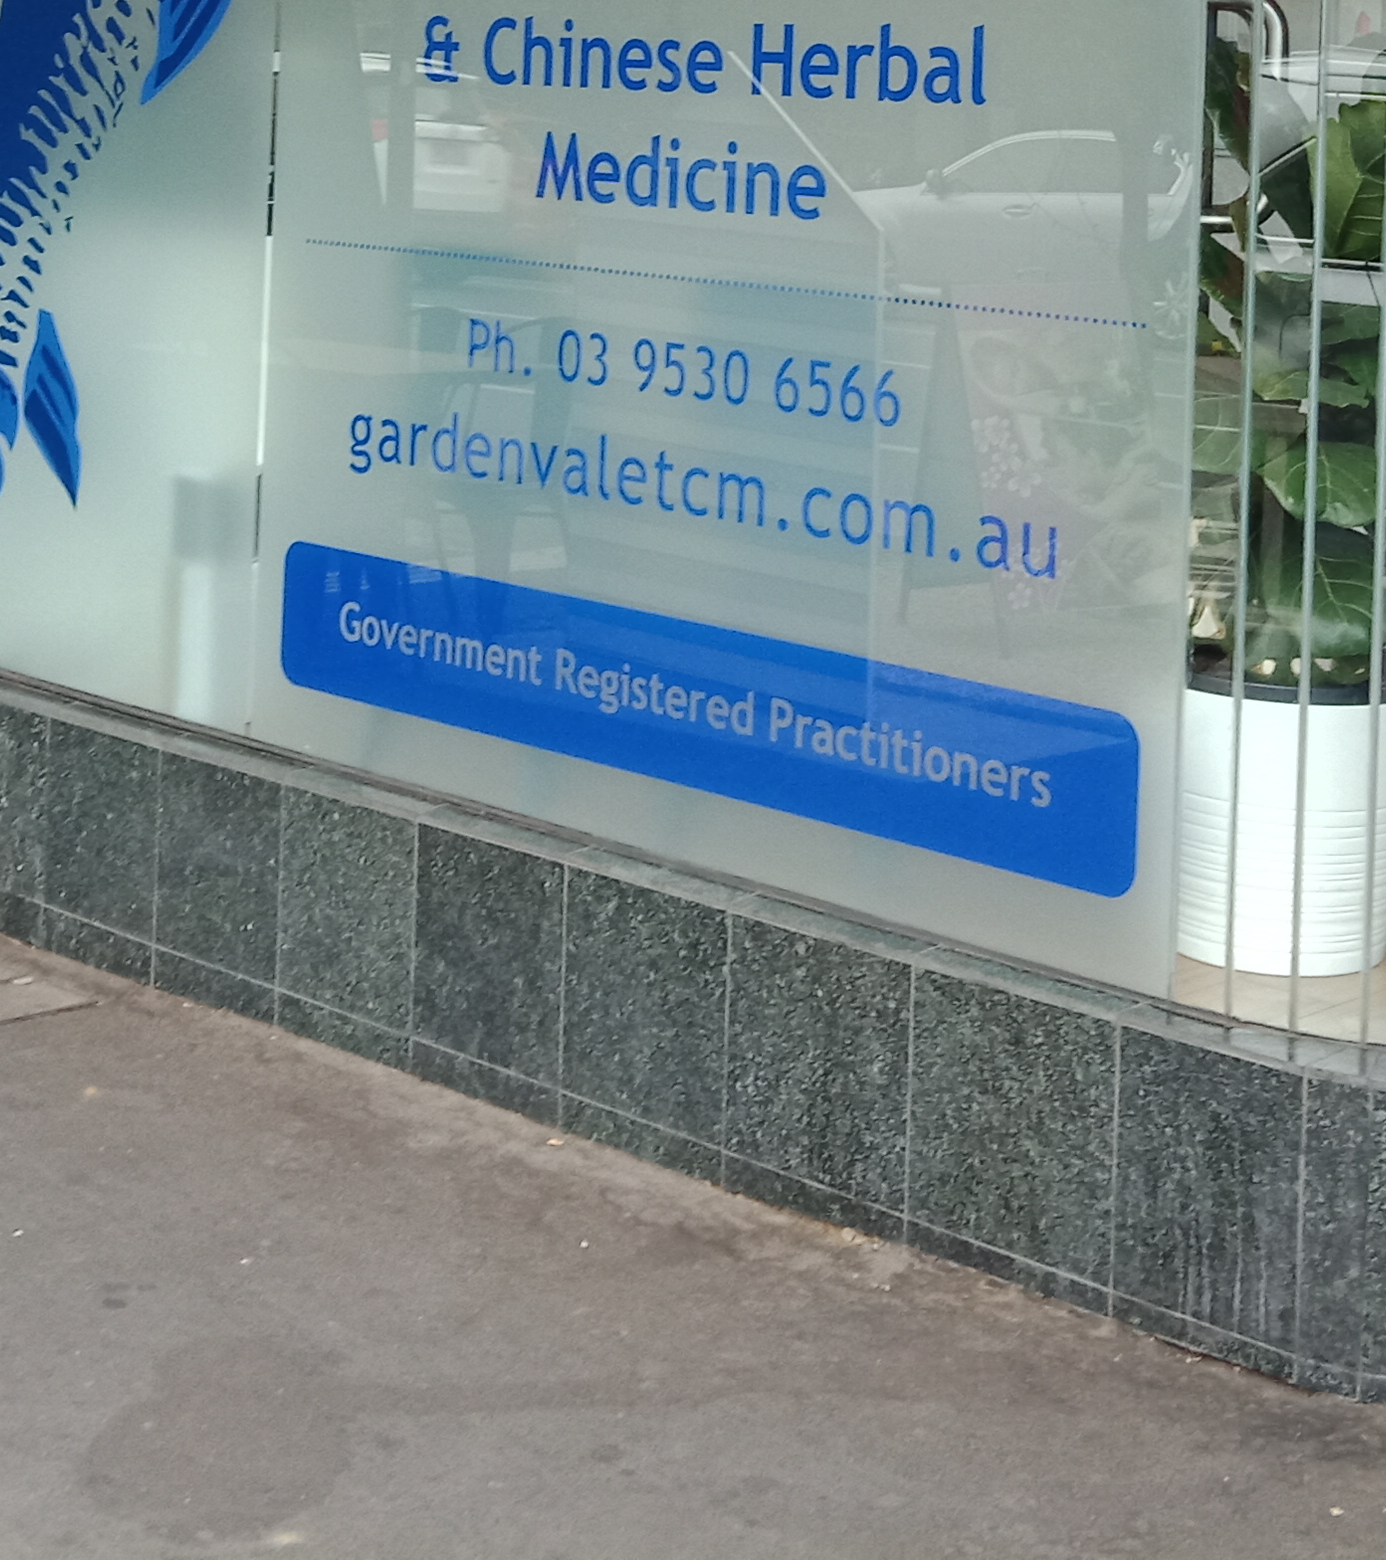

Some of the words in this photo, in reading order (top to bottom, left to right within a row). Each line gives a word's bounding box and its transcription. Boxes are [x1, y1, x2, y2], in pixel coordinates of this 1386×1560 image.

[423, 14, 462, 84] &
[482, 16, 725, 95] Chinese
[751, 22, 987, 106] Herbal
[536, 131, 828, 221] Medicine
[467, 317, 534, 378] Ph.
[556, 328, 610, 387] 03
[632, 337, 752, 407] 9530
[772, 356, 902, 428] 6566
[349, 411, 1059, 580] gardenvaletcm.com.au
[339, 600, 542, 689] Government
[553, 646, 755, 736] Registered
[768, 696, 1052, 809] Practitioners
